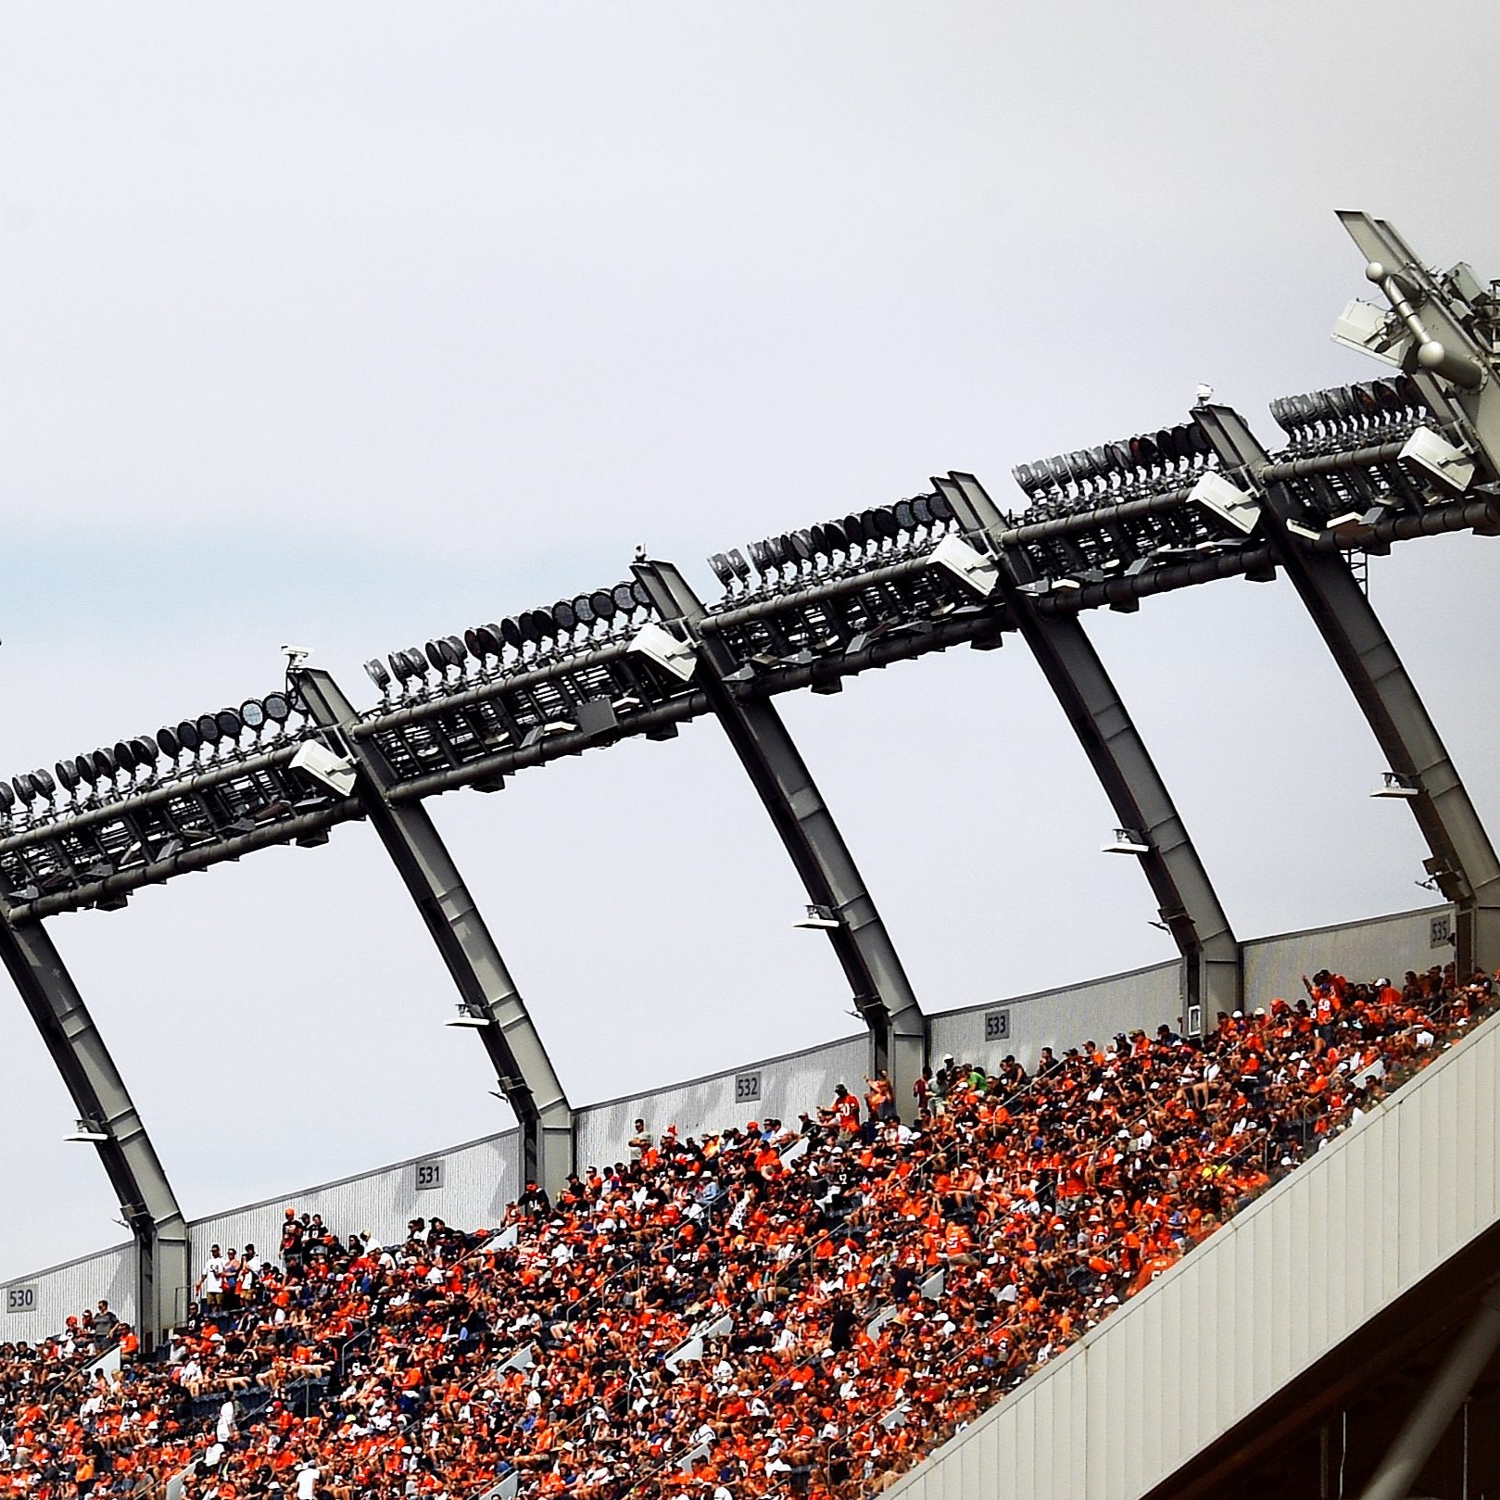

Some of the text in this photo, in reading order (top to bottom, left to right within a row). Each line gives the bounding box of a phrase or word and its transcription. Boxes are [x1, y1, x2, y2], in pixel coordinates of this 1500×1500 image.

[987, 1016, 1006, 1035] 533
[738, 1078, 757, 1096] 532
[419, 1166, 439, 1184] 531
[10, 1289, 33, 1307] 530
